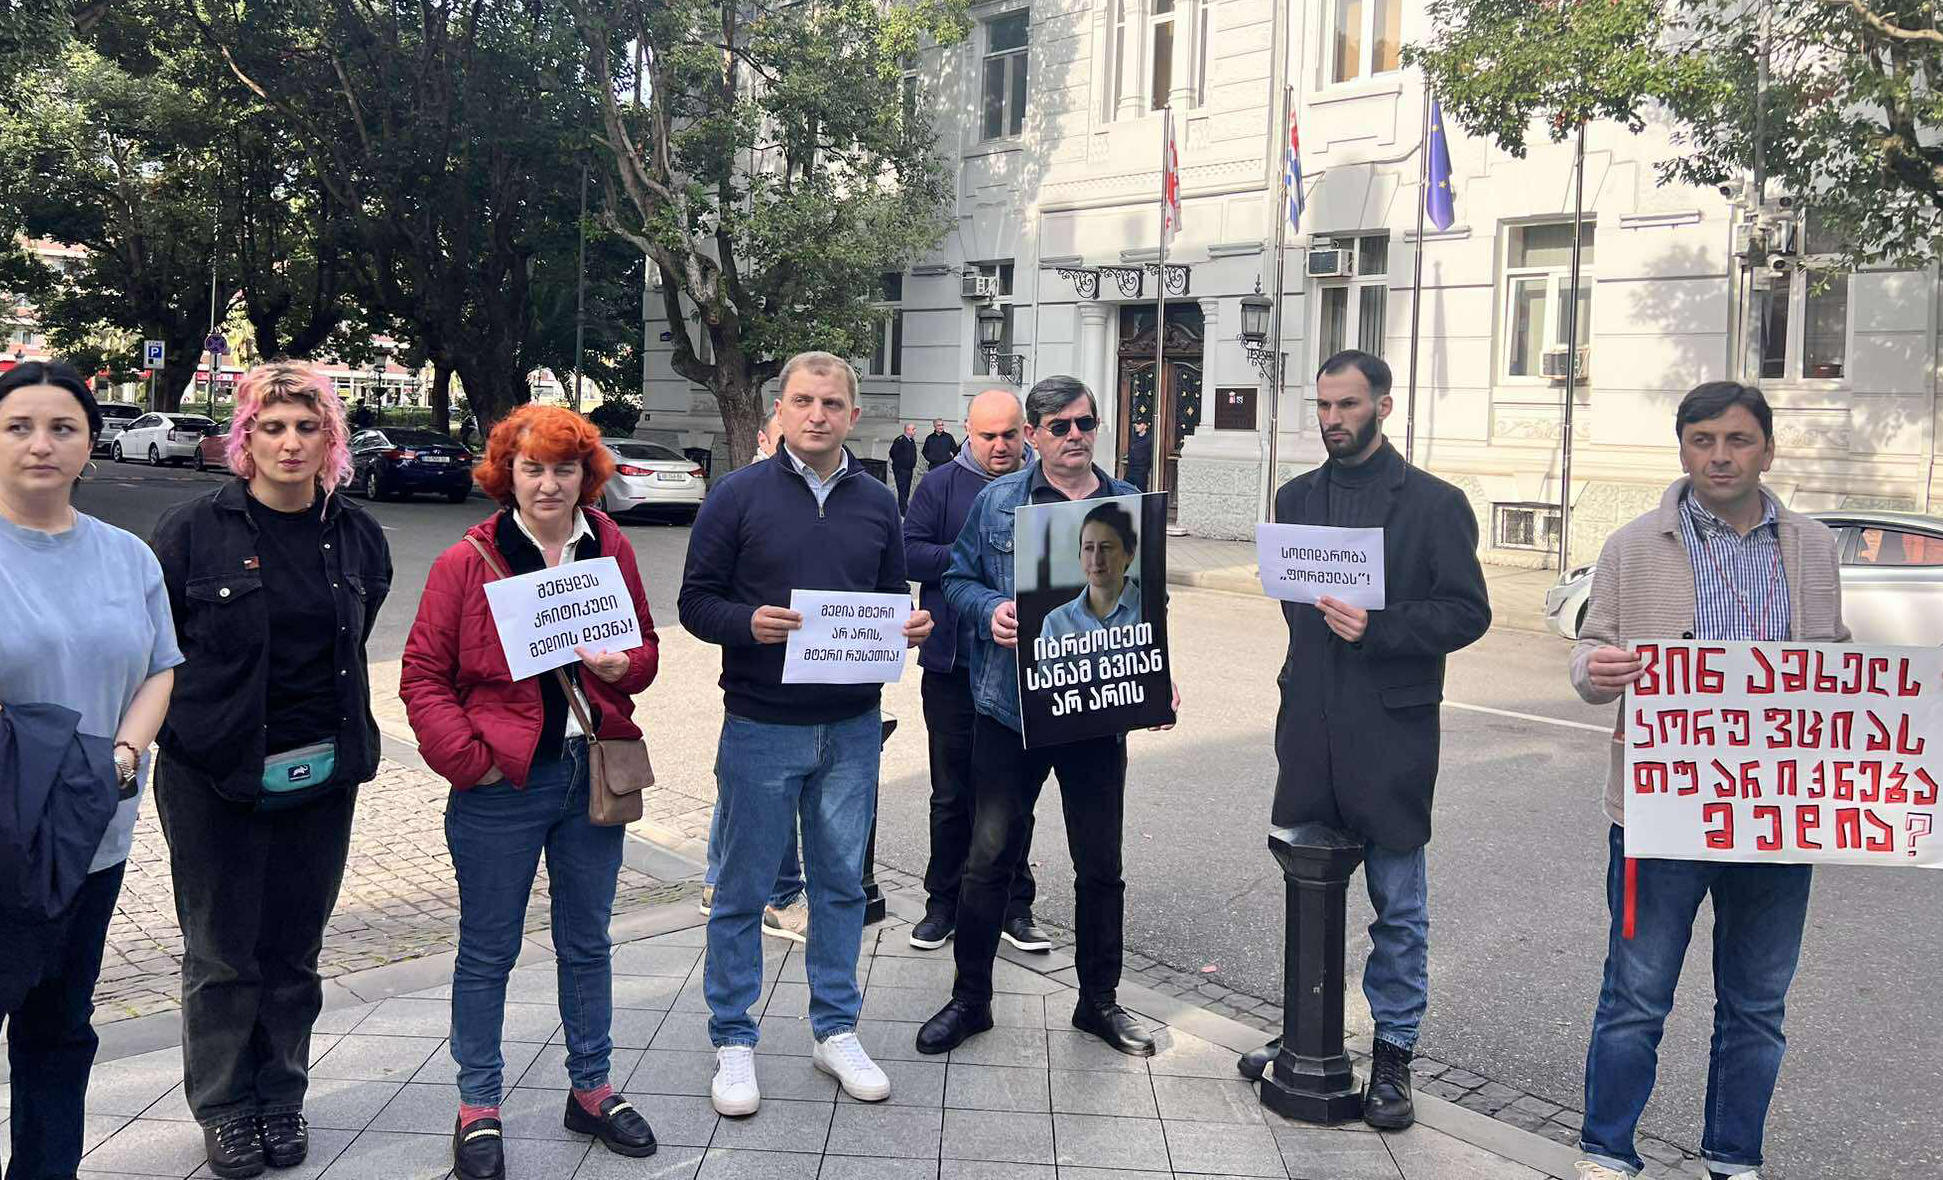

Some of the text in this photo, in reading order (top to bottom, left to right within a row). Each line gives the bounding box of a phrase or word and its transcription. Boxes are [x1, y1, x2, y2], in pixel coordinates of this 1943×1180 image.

[1281, 546, 1367, 563] სოლიდარობა
[536, 573, 600, 599] შეწყდეს
[534, 594, 618, 628] კრიტიკული
[821, 604, 895, 619] მედია მტერი
[529, 618, 634, 658] მედიის დევნა!
[832, 627, 883, 642] არ არის,
[1033, 622, 1153, 661] იბრძოლეთ
[804, 648, 900, 662] მტერი რუსეთია!
[1026, 648, 1163, 691] სანამ გვიან
[1633, 643, 1922, 698] ვინ ამხელს
[1051, 680, 1145, 717] არ არის
[1632, 759, 1699, 797] თუ
[1710, 758, 1763, 799] არ
